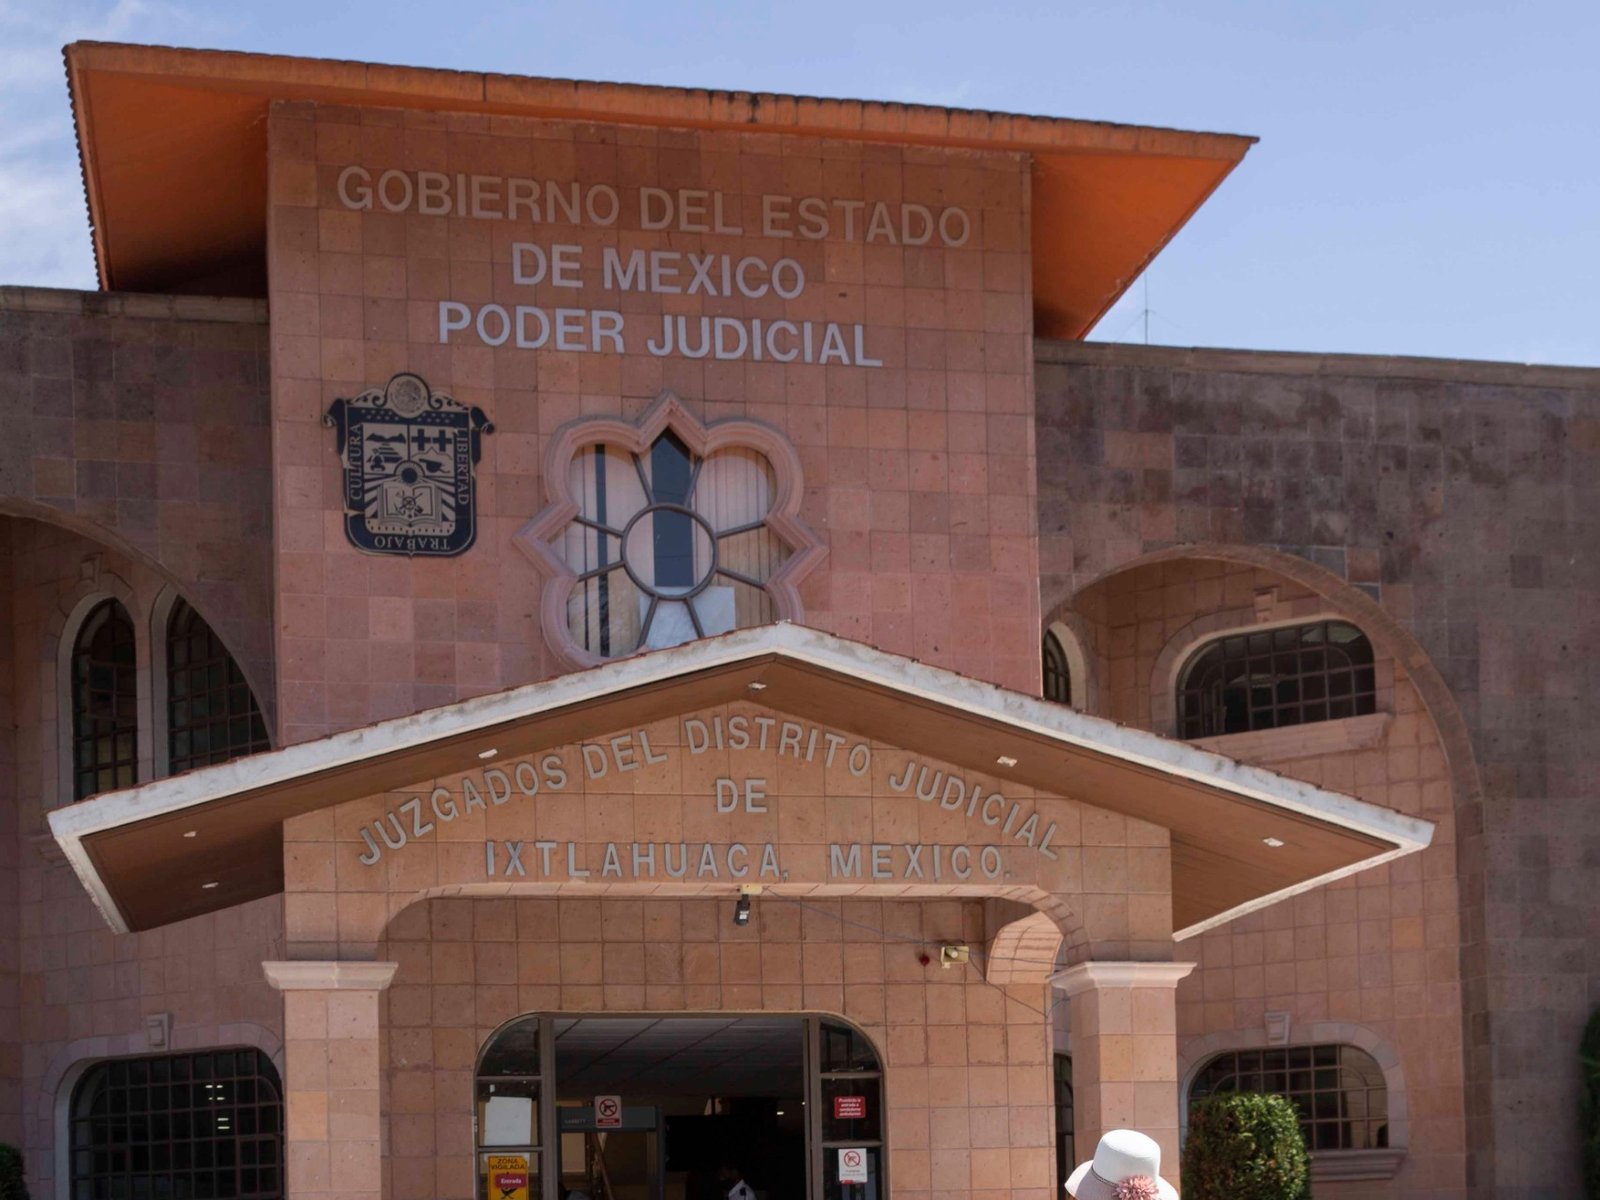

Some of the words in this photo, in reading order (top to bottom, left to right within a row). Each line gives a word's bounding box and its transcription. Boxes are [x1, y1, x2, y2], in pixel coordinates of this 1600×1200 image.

[336, 165, 620, 226] GOBIERNO
[639, 186, 743, 235] DEL
[761, 194, 971, 248] ESTADO
[511, 242, 584, 289] DE
[603, 247, 805, 301] MEXICO
[438, 301, 625, 354] PODER
[646, 314, 884, 368] JUDICIAL
[350, 423, 363, 500] CULTURA
[456, 427, 470, 506] LIBERTAD
[374, 536, 450, 551] TRABAJO
[358, 754, 568, 867] JUZGADOS
[581, 729, 669, 781] DEL
[683, 715, 872, 778] DISTRITO
[888, 759, 1060, 862] JUDICIAL
[716, 778, 769, 814] DE
